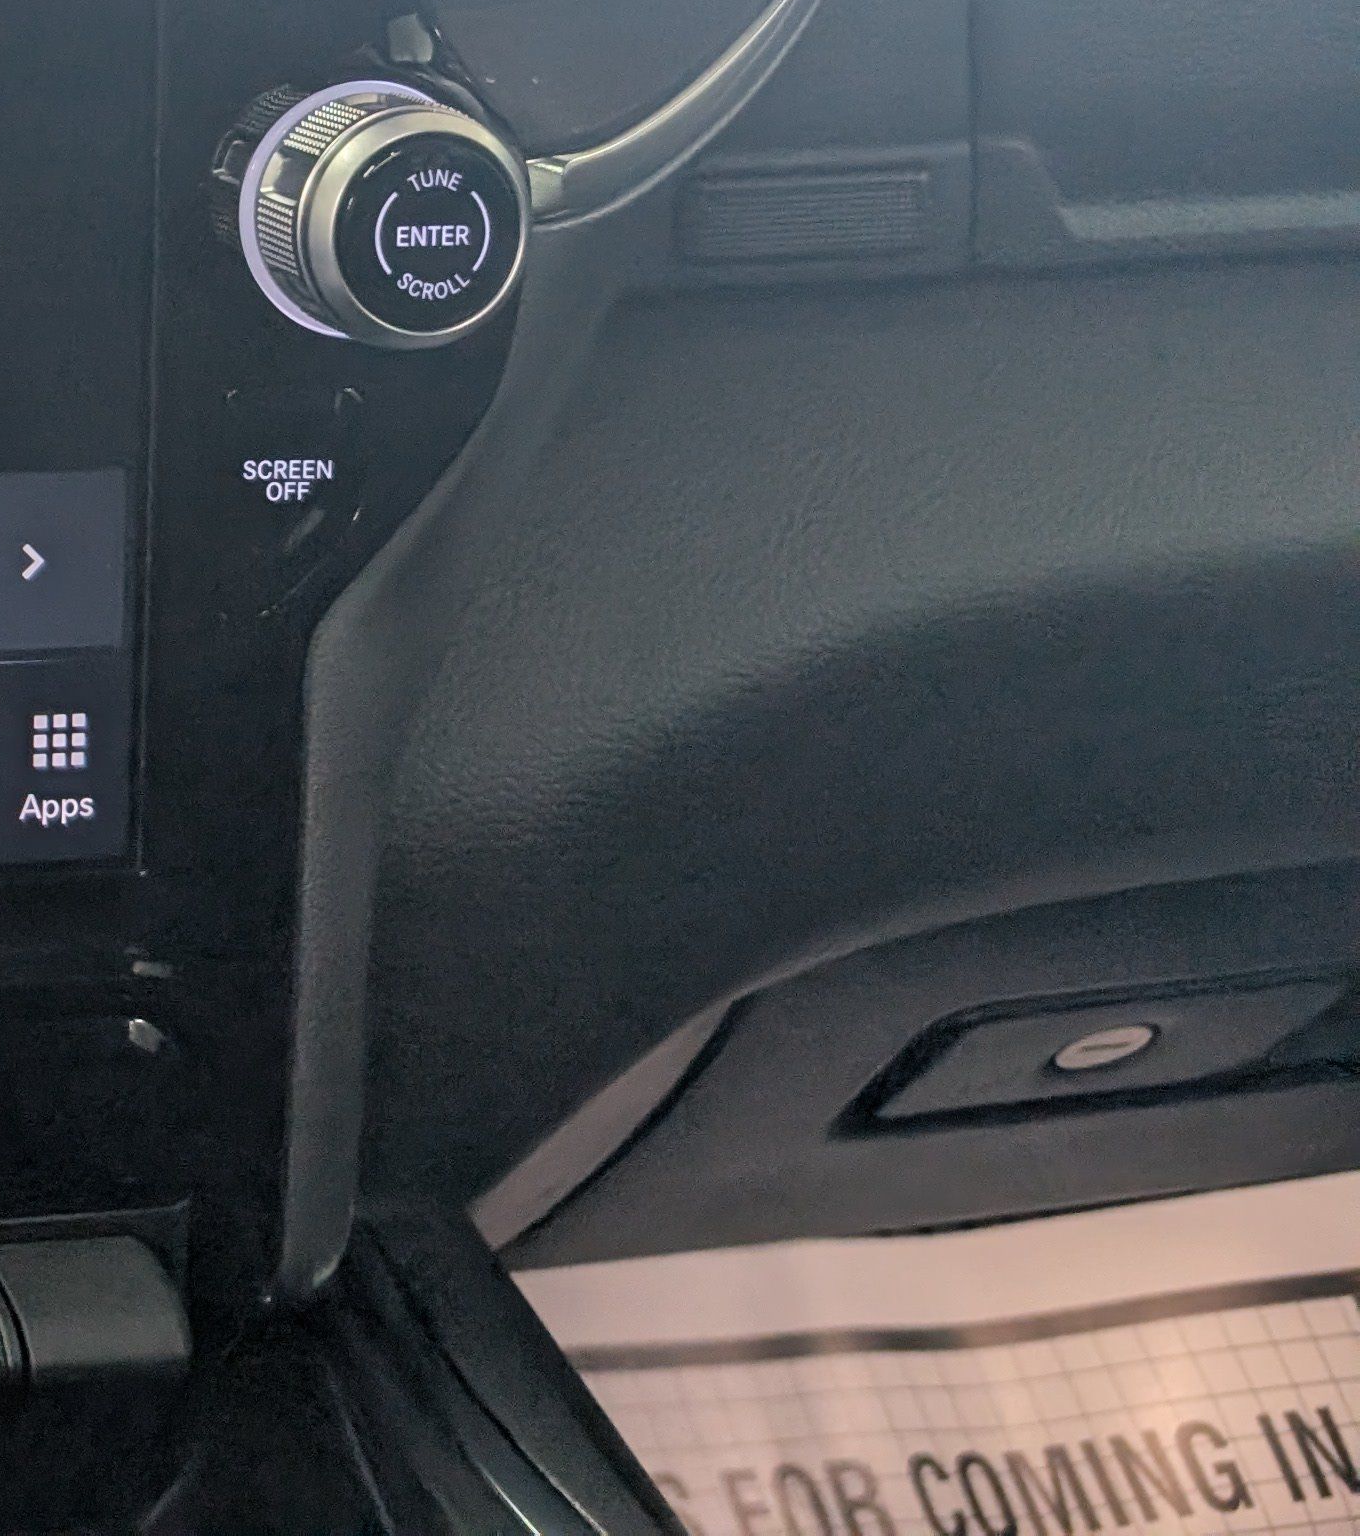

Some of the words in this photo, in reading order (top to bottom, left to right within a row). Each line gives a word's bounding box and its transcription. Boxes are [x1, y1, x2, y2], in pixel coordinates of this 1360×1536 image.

[407, 168, 464, 192] TUNE
[396, 225, 470, 247] ENTER
[397, 271, 470, 301] SCROLL
[243, 459, 333, 480] SCREEN
[266, 481, 309, 501] OFF
[19, 794, 94, 825] Apps
[720, 1458, 897, 1536] FOR
[908, 1419, 1254, 1536] COMING
[1256, 1406, 1360, 1504] IN
